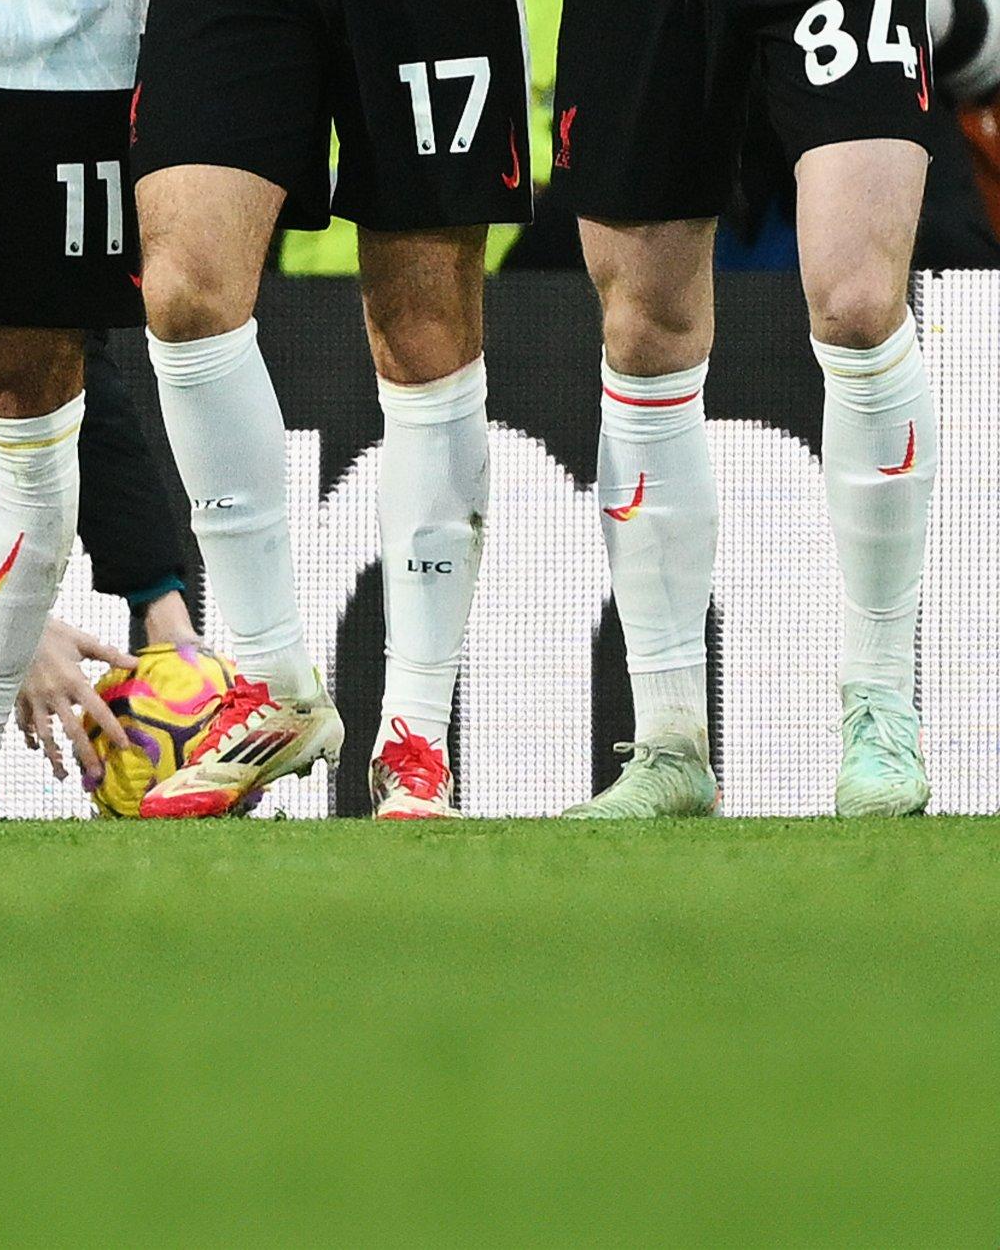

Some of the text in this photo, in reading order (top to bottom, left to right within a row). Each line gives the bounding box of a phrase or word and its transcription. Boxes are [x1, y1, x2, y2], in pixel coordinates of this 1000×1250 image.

[399, 56, 491, 155] 17
[56, 160, 123, 257] 11
[407, 559, 452, 574] LFC
